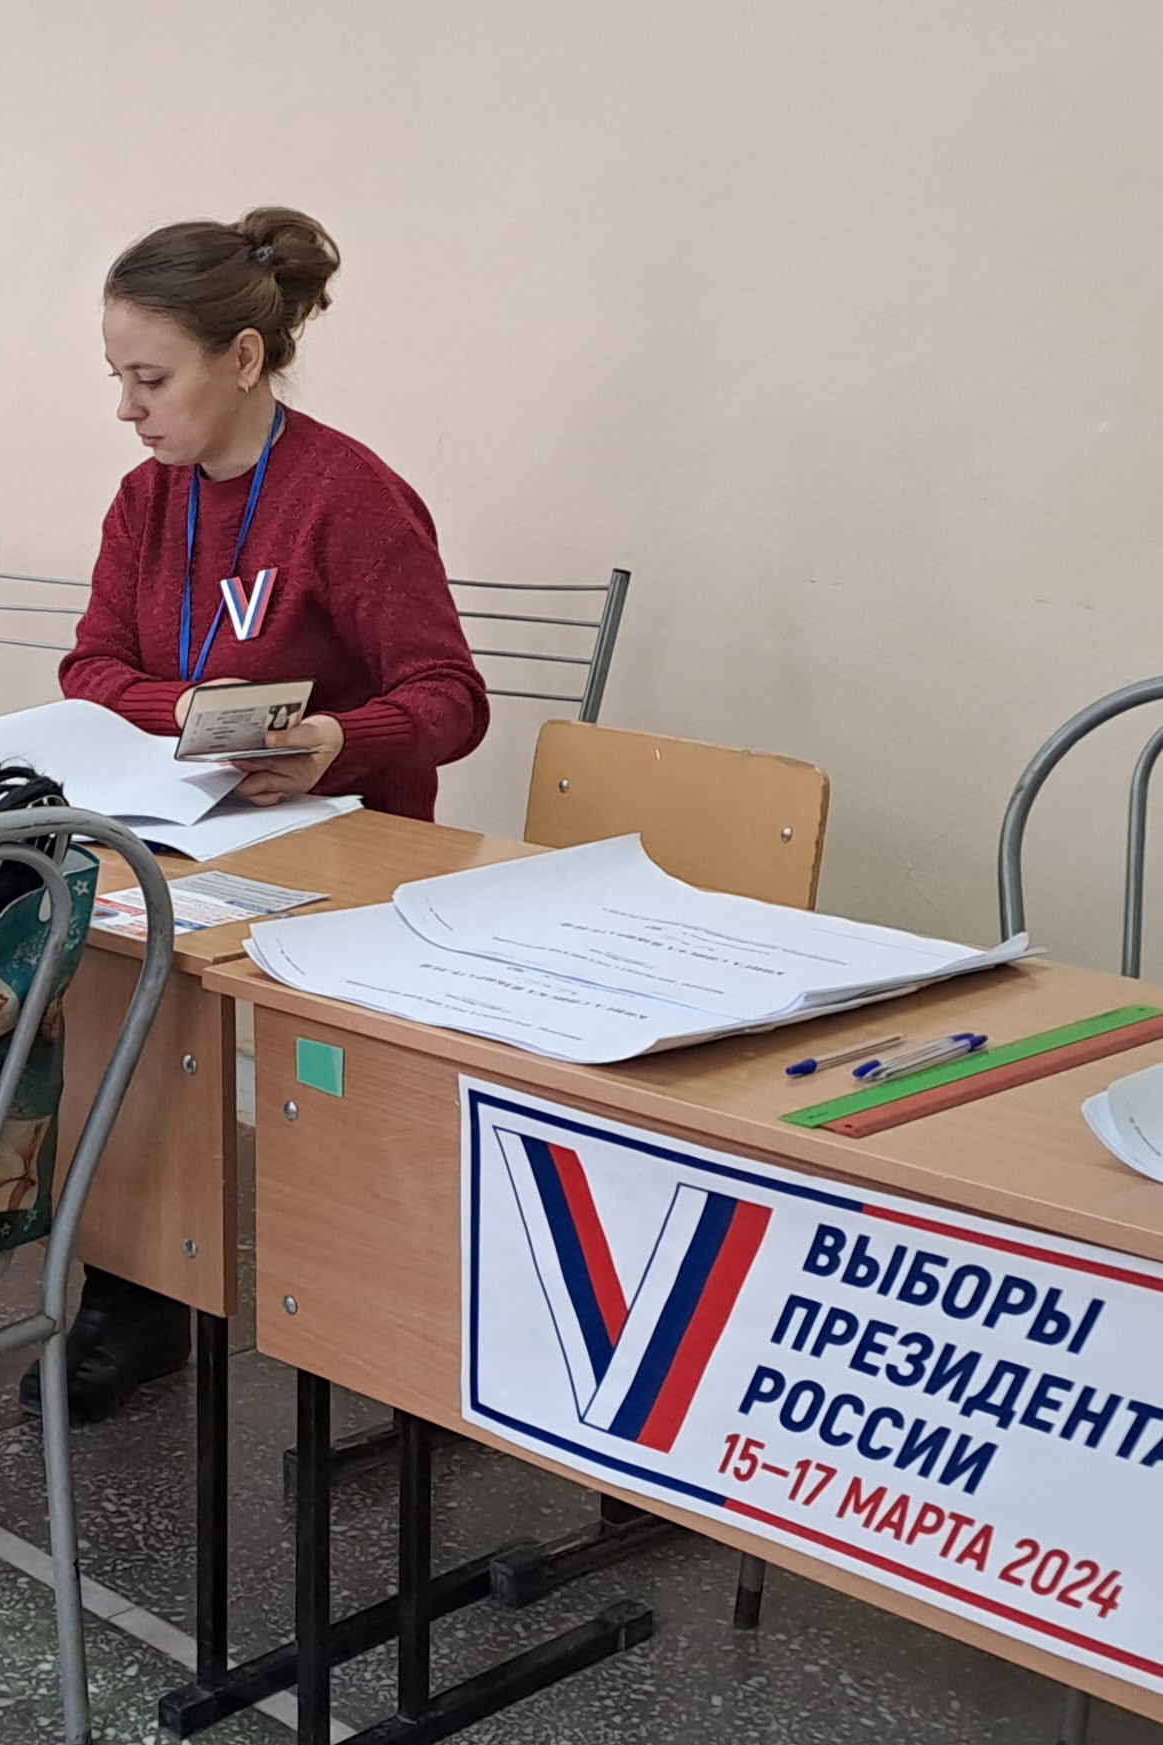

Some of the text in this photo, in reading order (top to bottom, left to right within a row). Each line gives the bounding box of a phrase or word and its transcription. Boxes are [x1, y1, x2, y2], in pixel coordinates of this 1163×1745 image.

[802, 1223, 1106, 1355] ВЫБОРЫ
[738, 1364, 999, 1496] РОССИИ
[836, 1476, 995, 1572] МАРТА
[999, 1537, 1123, 1620] 2024
